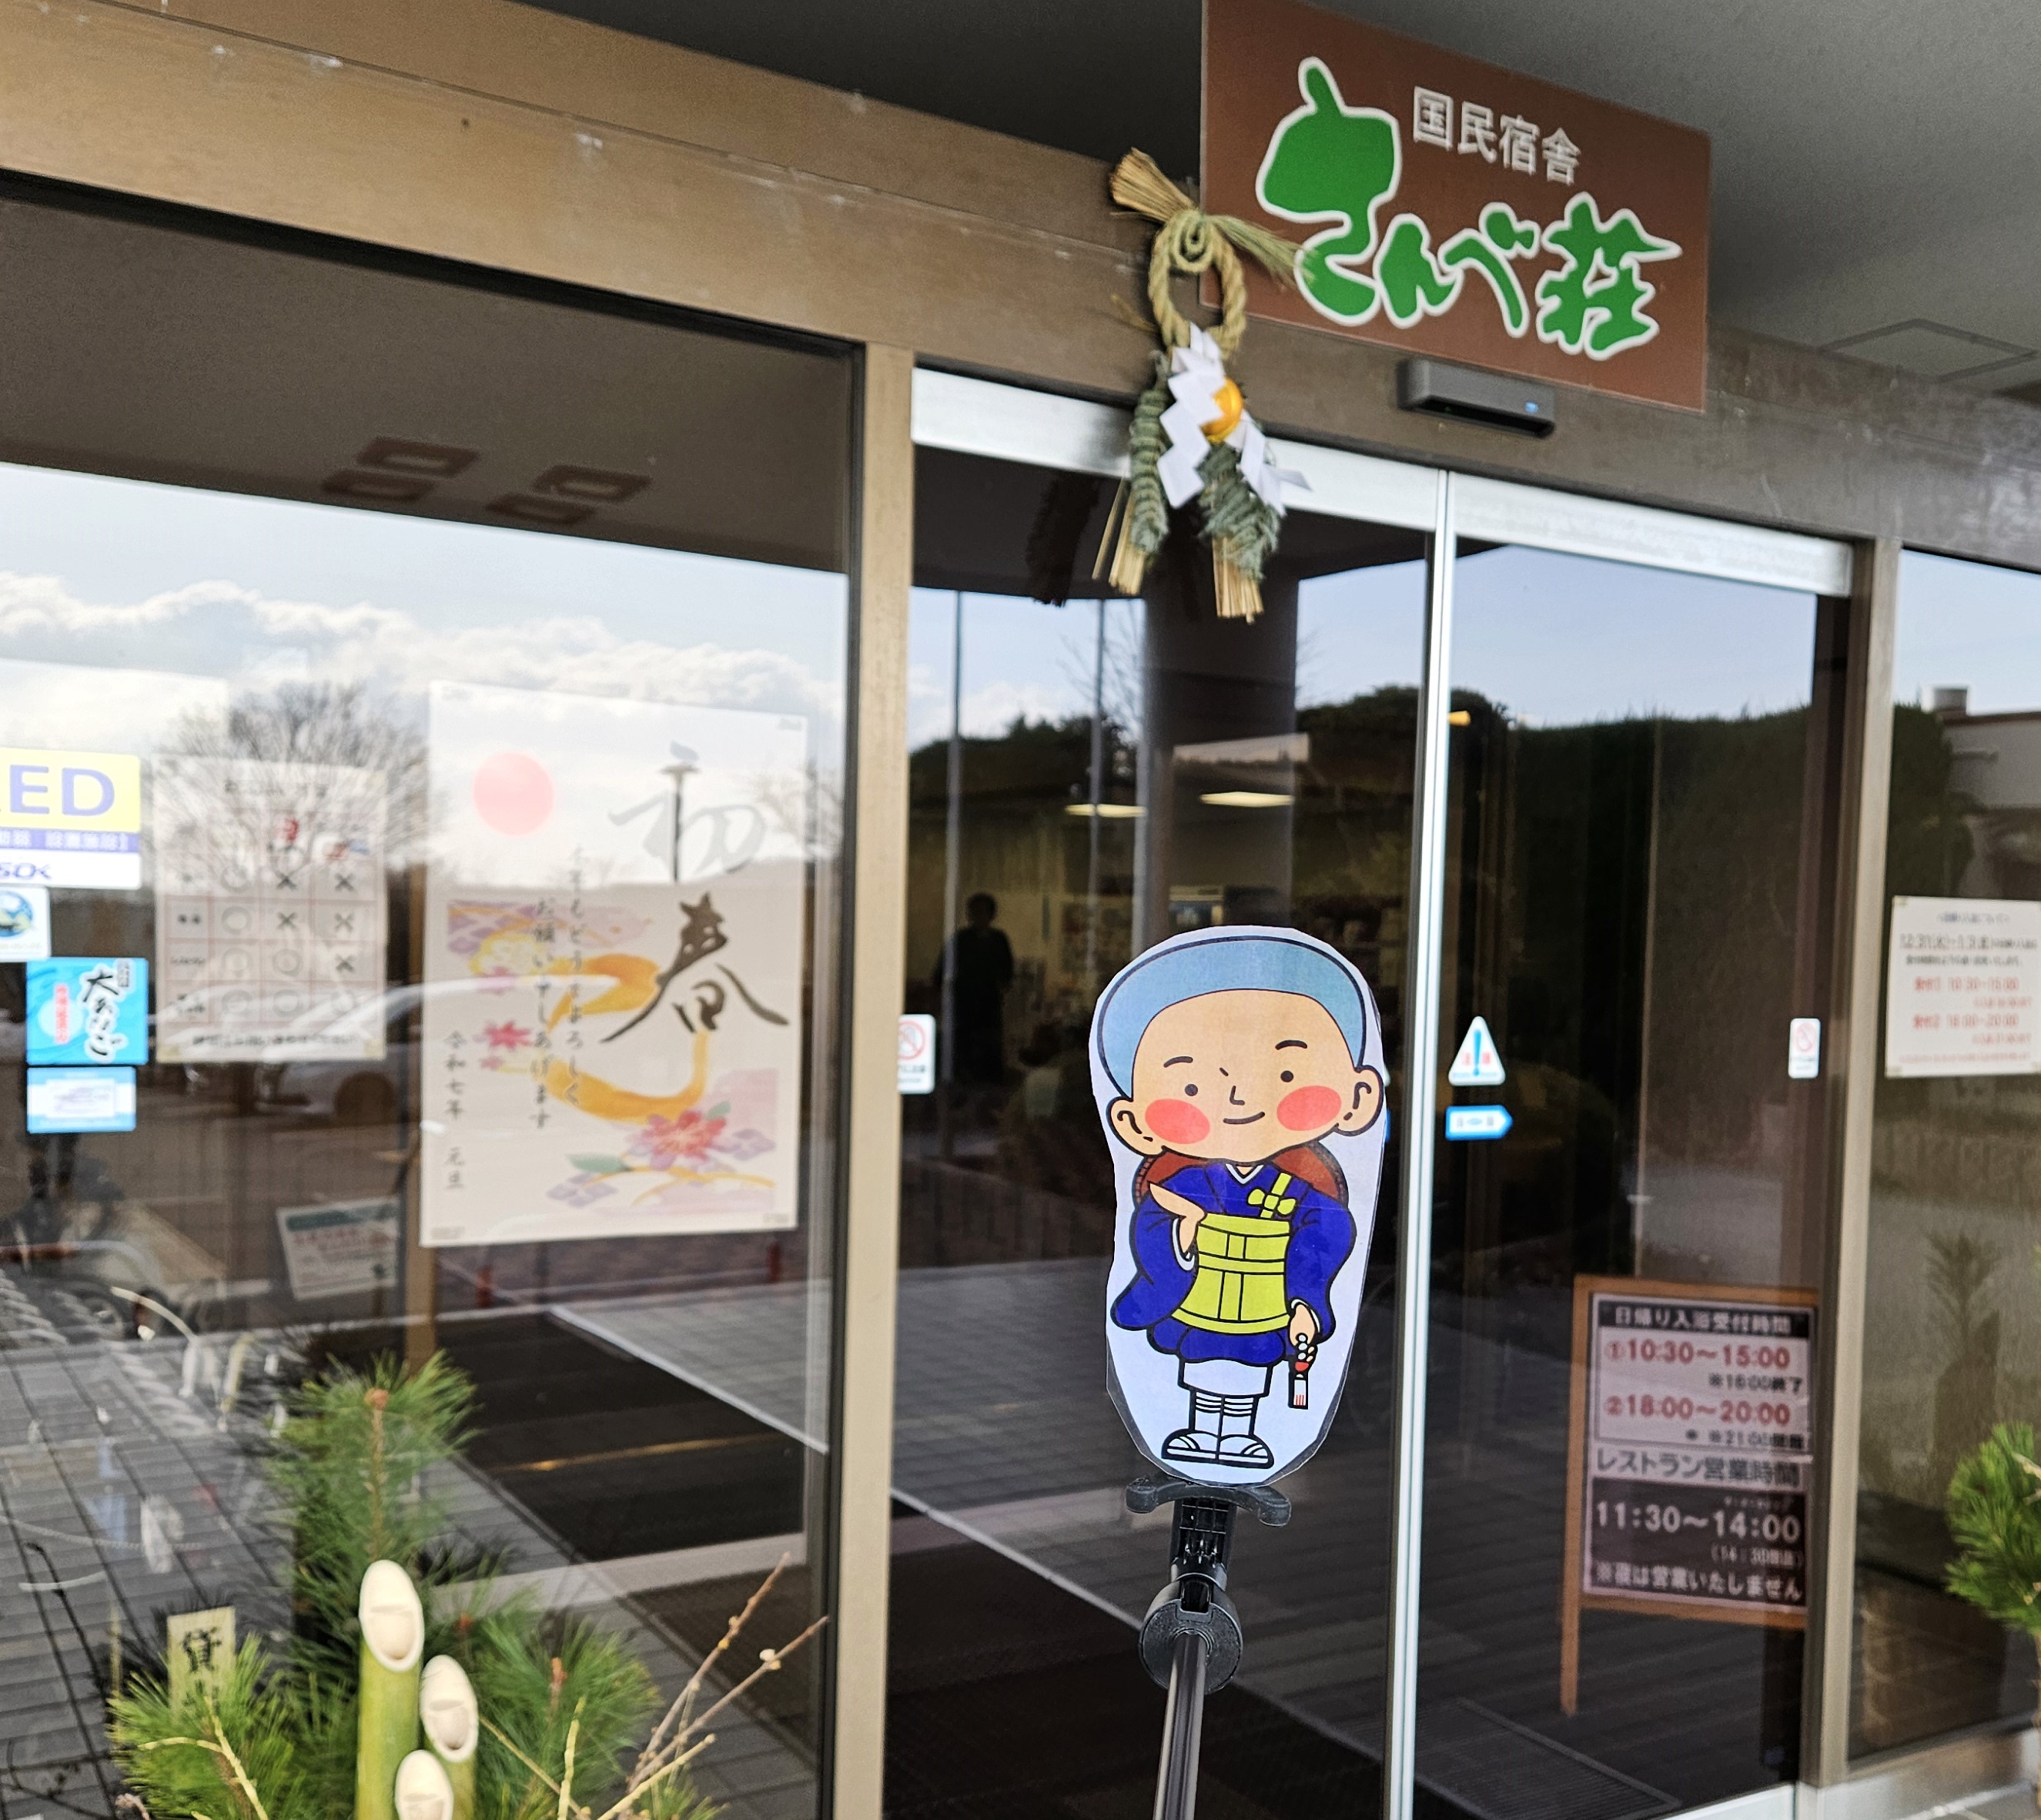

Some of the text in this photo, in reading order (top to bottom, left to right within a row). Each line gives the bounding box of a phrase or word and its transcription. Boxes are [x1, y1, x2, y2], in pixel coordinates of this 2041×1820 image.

[1414, 86, 1581, 185] 国民宿舎
[1256, 56, 1682, 361] さんべ荘
[0, 764, 115, 816] ED
[0, 861, 51, 879] SOK
[599, 741, 793, 1044] 初春
[1615, 1305, 1792, 1335] 日帰り入浴受付時間
[1597, 1447, 1801, 1487] レストラン営業時間
